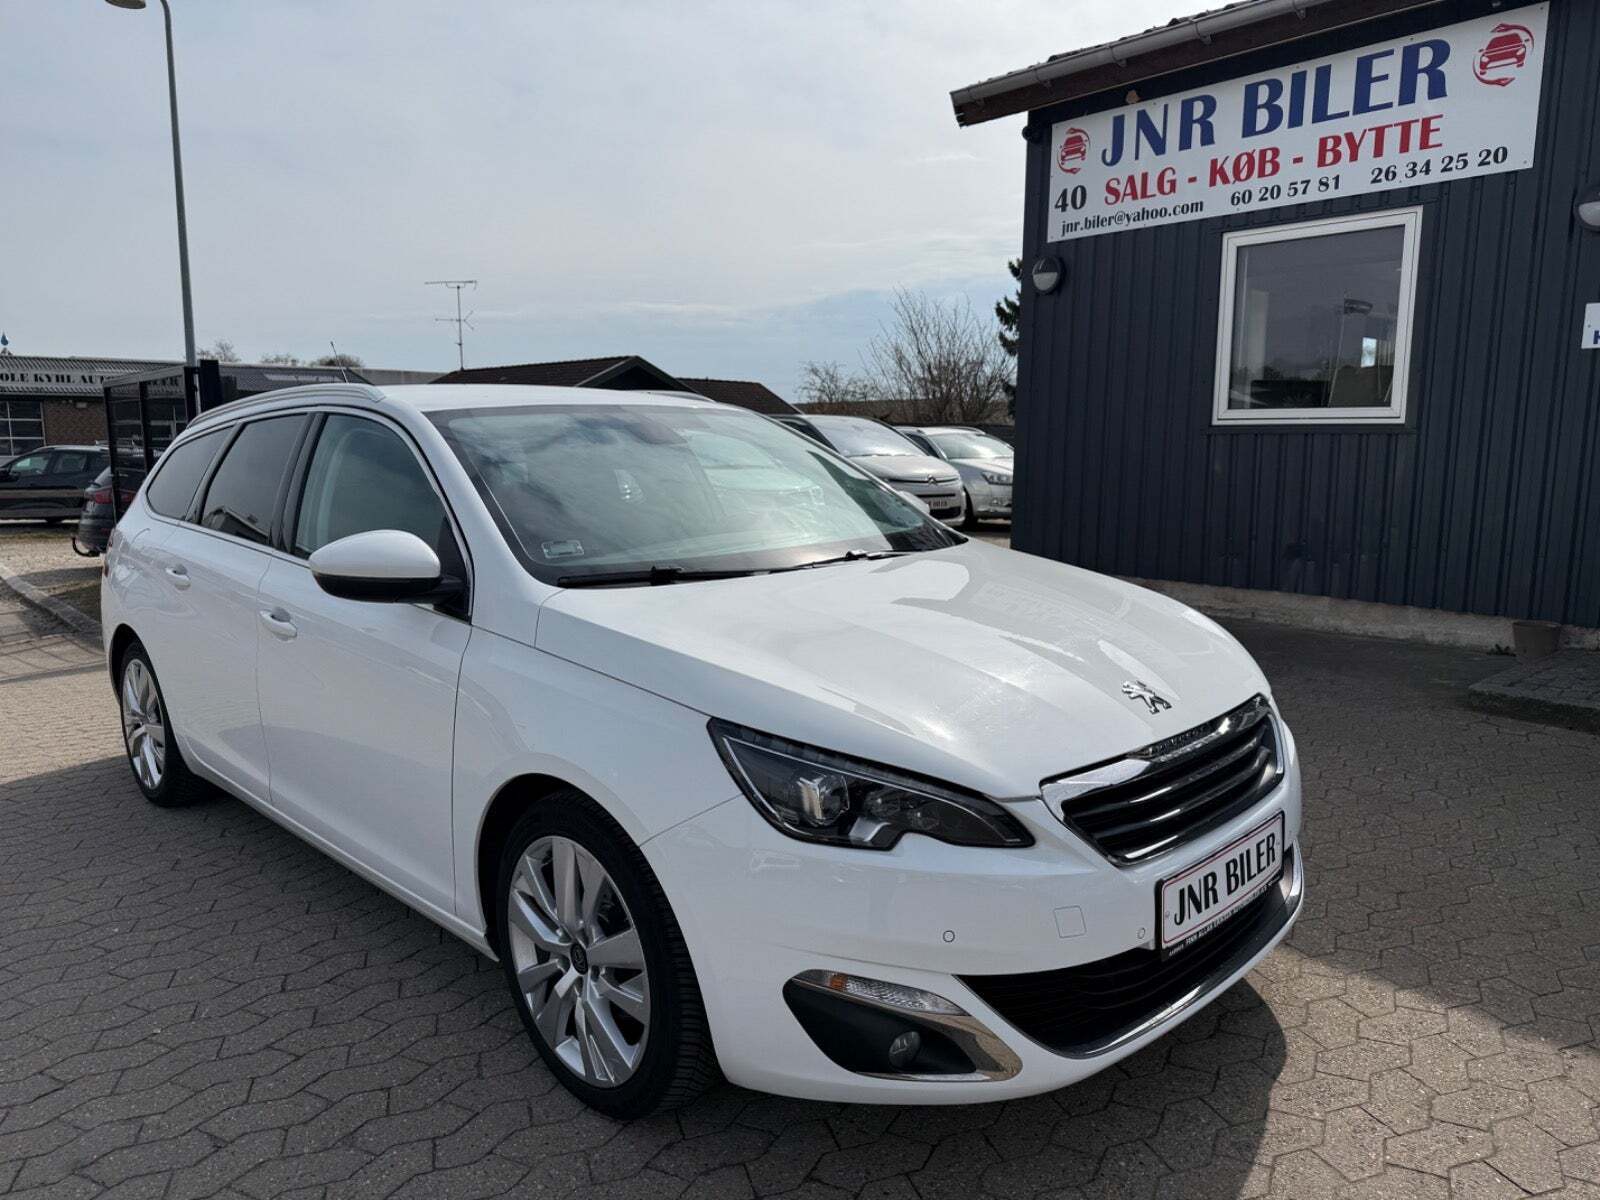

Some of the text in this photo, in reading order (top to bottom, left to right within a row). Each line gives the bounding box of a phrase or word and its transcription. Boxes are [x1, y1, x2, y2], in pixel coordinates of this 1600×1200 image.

[1102, 38, 1451, 167] JNR BILER
[1104, 167, 1177, 206] SALG
[1208, 146, 1281, 188] KØB
[1317, 114, 1444, 168] BYTTE
[1370, 146, 1508, 184] 26 34 25 20
[1054, 185, 1087, 213] 40
[1230, 174, 1340, 207] 60 20 57 81
[1061, 200, 1204, 237] jnr.biler@yahoo.com
[1174, 832, 1276, 926] JNR BILER
